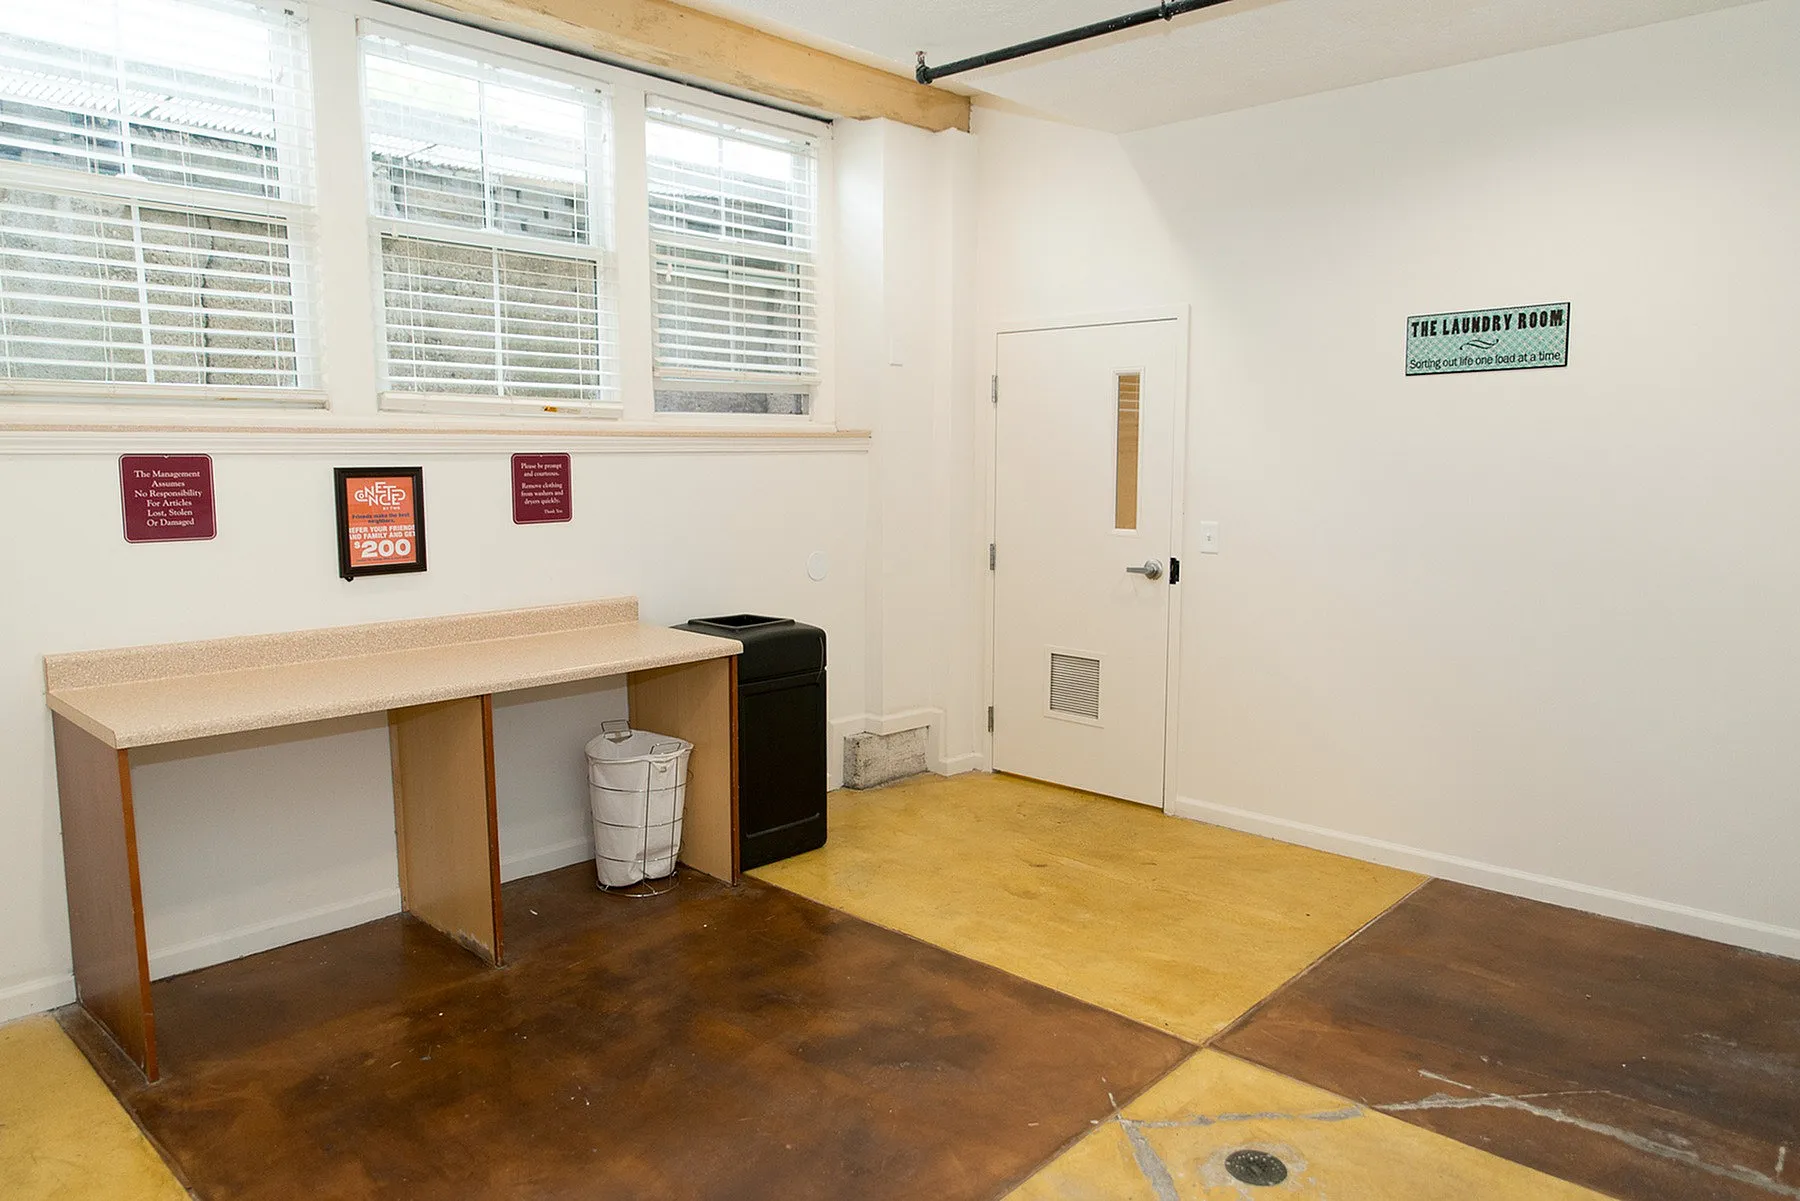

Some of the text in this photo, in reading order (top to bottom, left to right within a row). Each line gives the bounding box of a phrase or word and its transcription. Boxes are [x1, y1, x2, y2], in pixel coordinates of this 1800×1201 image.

[1411, 309, 1564, 337] THE LAUNDRY ROOM
[1410, 350, 1560, 370] Sorting out life one load at a time
[152, 470, 200, 478] Management
[150, 489, 202, 498] Responsibility
[160, 518, 195, 526] Damaged
[353, 539, 411, 558] $200
